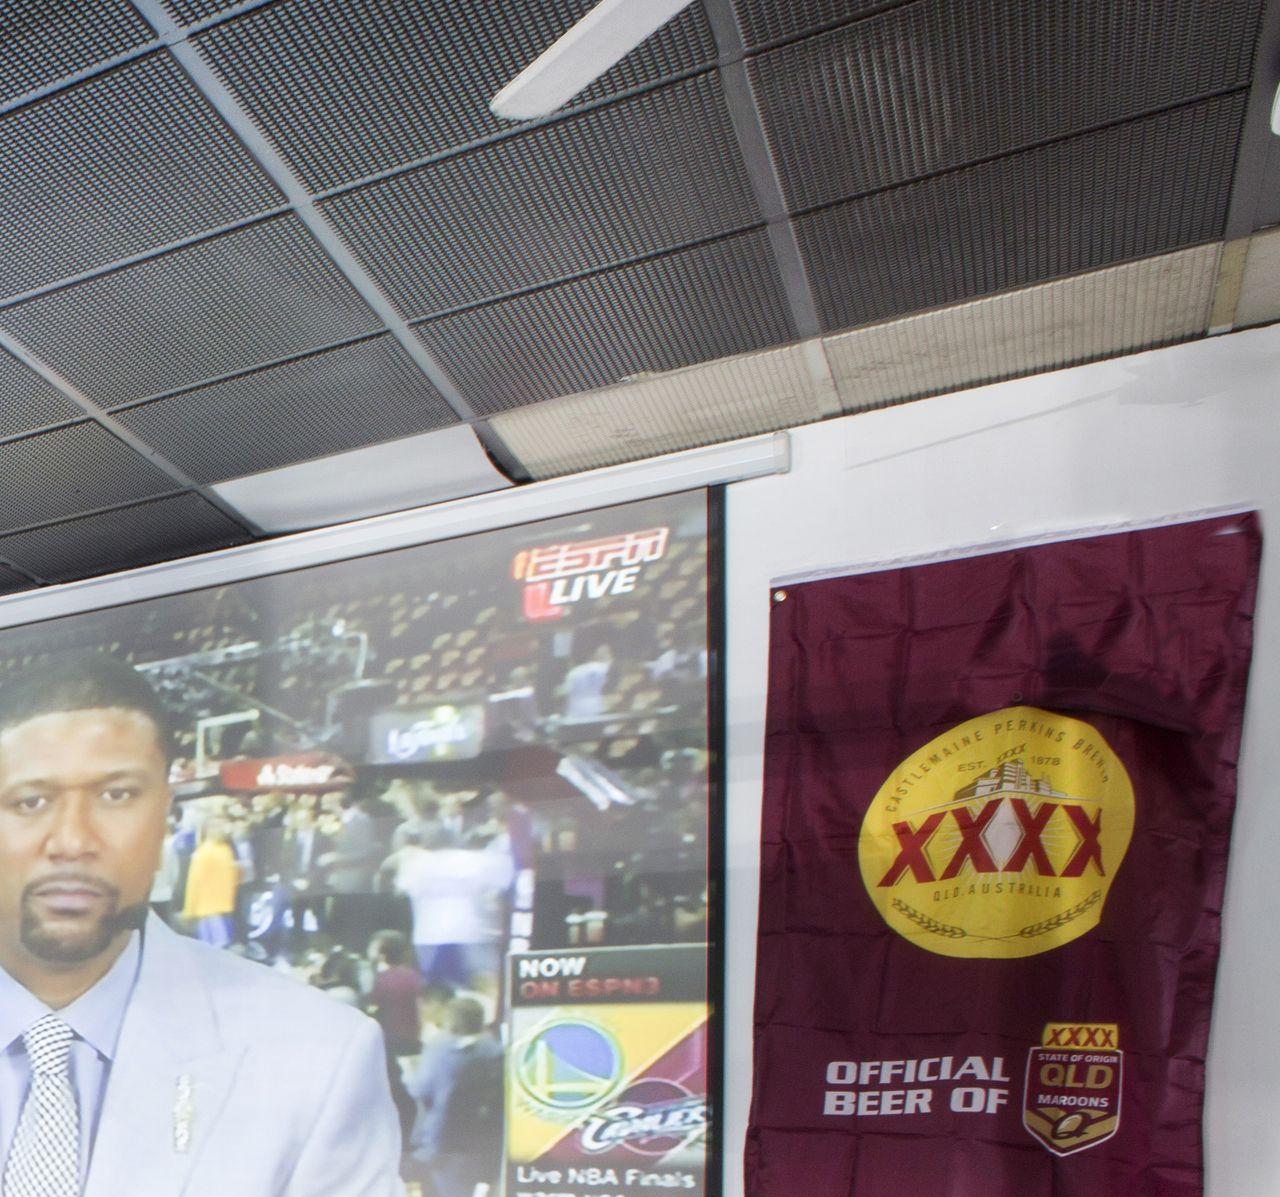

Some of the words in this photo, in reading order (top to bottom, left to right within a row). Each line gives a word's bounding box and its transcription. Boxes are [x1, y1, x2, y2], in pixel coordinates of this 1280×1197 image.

[526, 527, 670, 582] ESPN
[549, 565, 641, 605] LIVE
[886, 730, 983, 813] CASTLEMAINE
[994, 719, 1066, 743] PERKINS
[957, 760, 987, 773] EST.
[1031, 755, 1061, 766] 1878
[876, 797, 1106, 888] XXXX
[518, 957, 587, 978] NOW
[520, 980, 561, 998] ON
[1044, 1027, 1115, 1048] XXXX
[1038, 1053, 1069, 1062] STATE
[1070, 1054, 1083, 1062] OF
[825, 1056, 1011, 1085] OFFICIAL
[1040, 1064, 1113, 1089] QLD
[823, 1088, 933, 1116] BEER
[950, 1087, 1010, 1114] OF
[1038, 1094, 1109, 1108] MAROONS
[516, 1166, 562, 1184] Live
[568, 1167, 619, 1186] NBA
[625, 1168, 696, 1188] Finals
